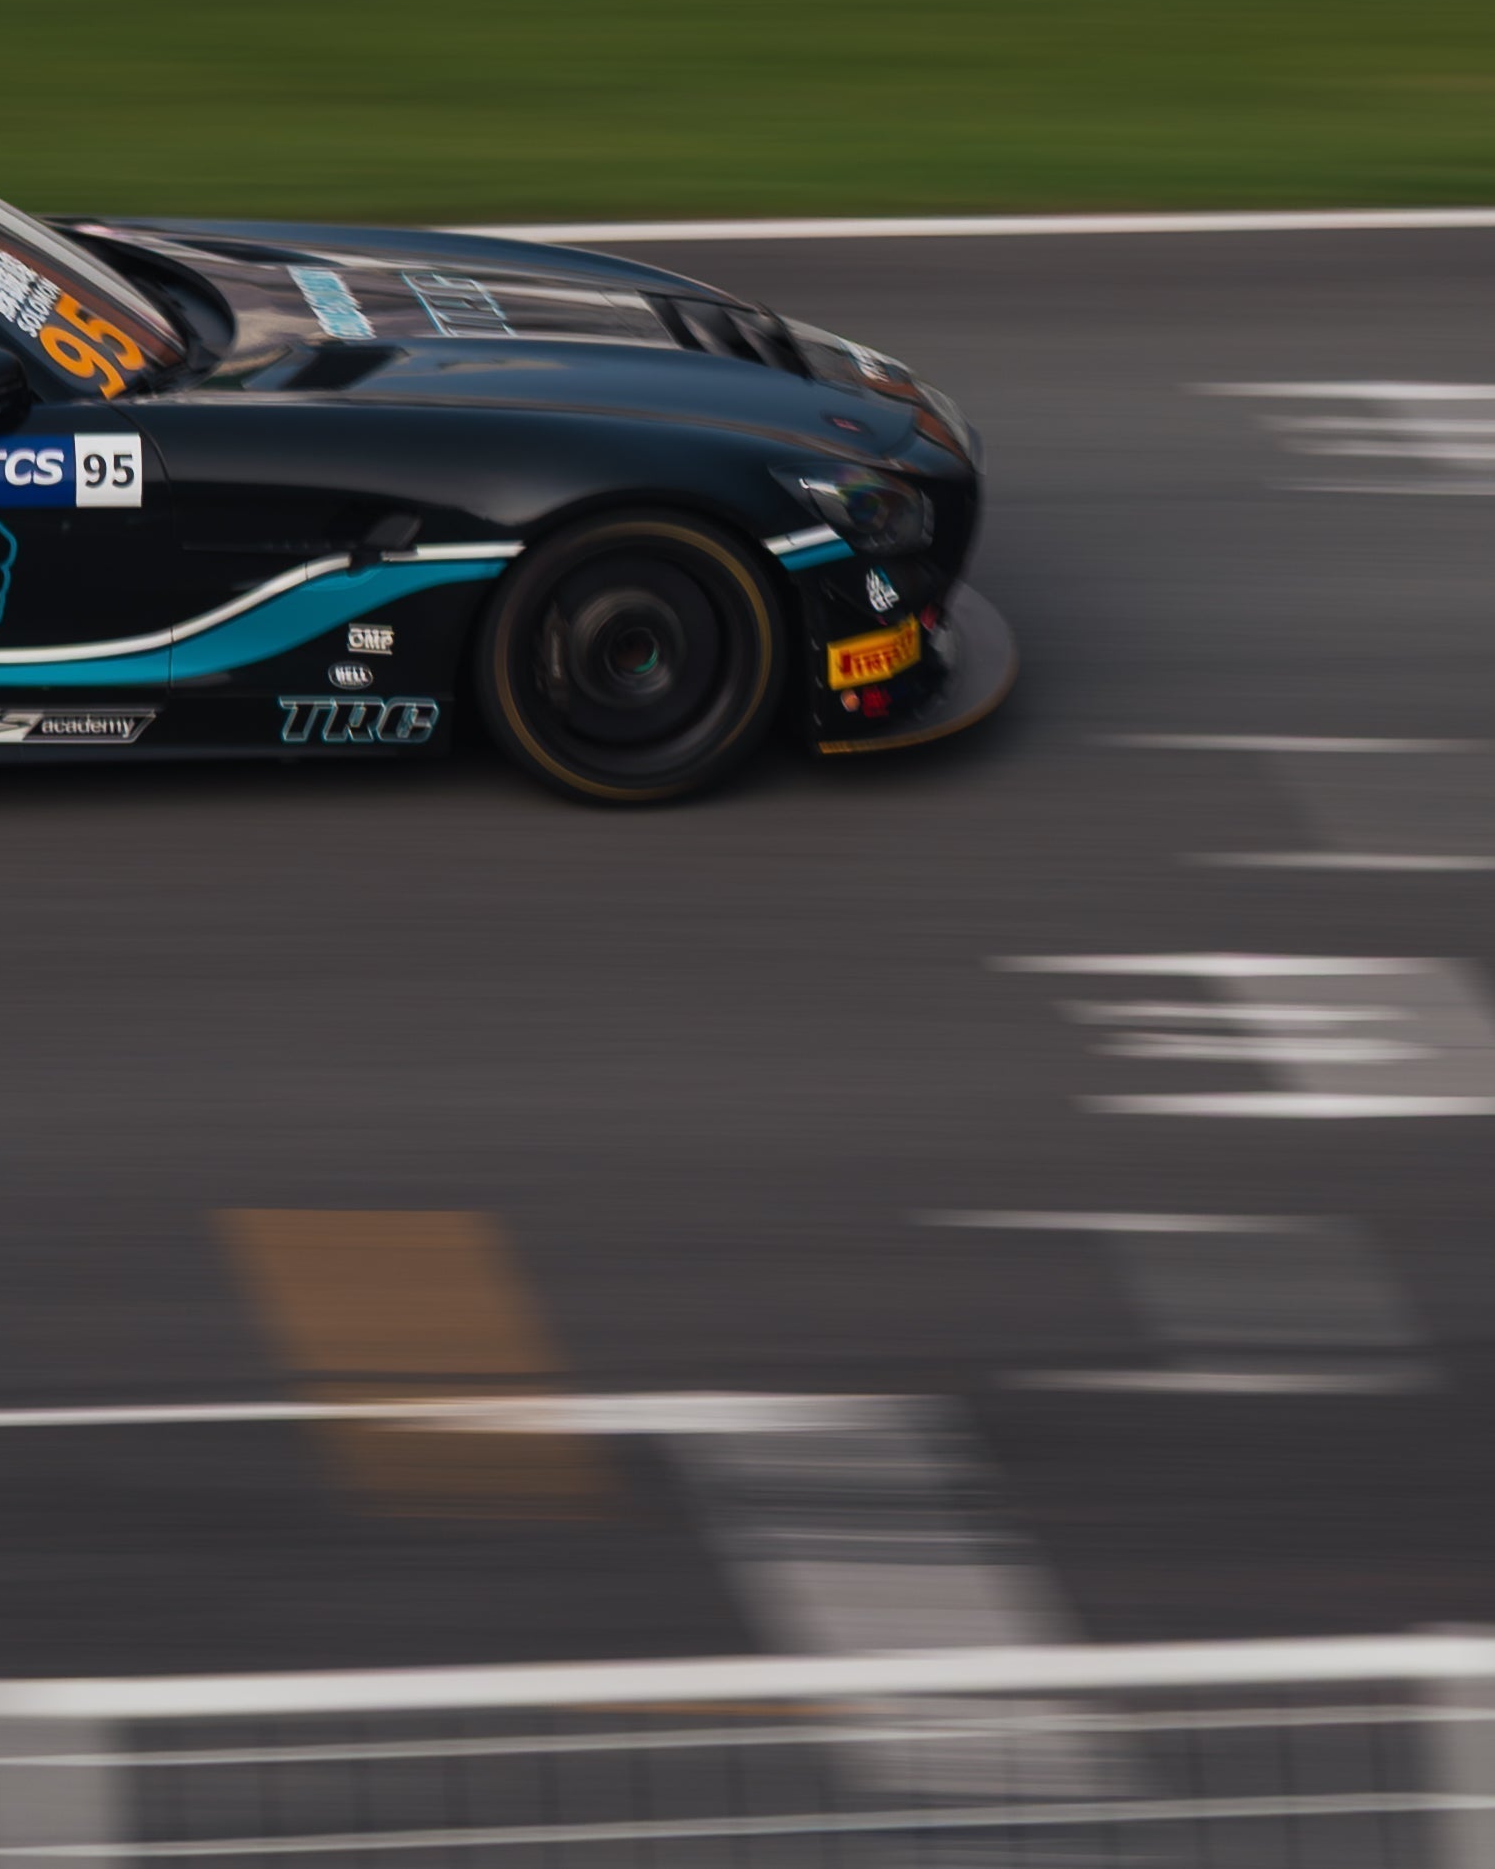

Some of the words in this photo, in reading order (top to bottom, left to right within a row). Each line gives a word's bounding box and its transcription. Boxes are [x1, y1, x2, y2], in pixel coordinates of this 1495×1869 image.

[39, 293, 146, 399] 95
[83, 453, 136, 489] 95
[348, 627, 394, 650] OMP
[41, 714, 135, 738] academy
[277, 695, 440, 743] TRC
